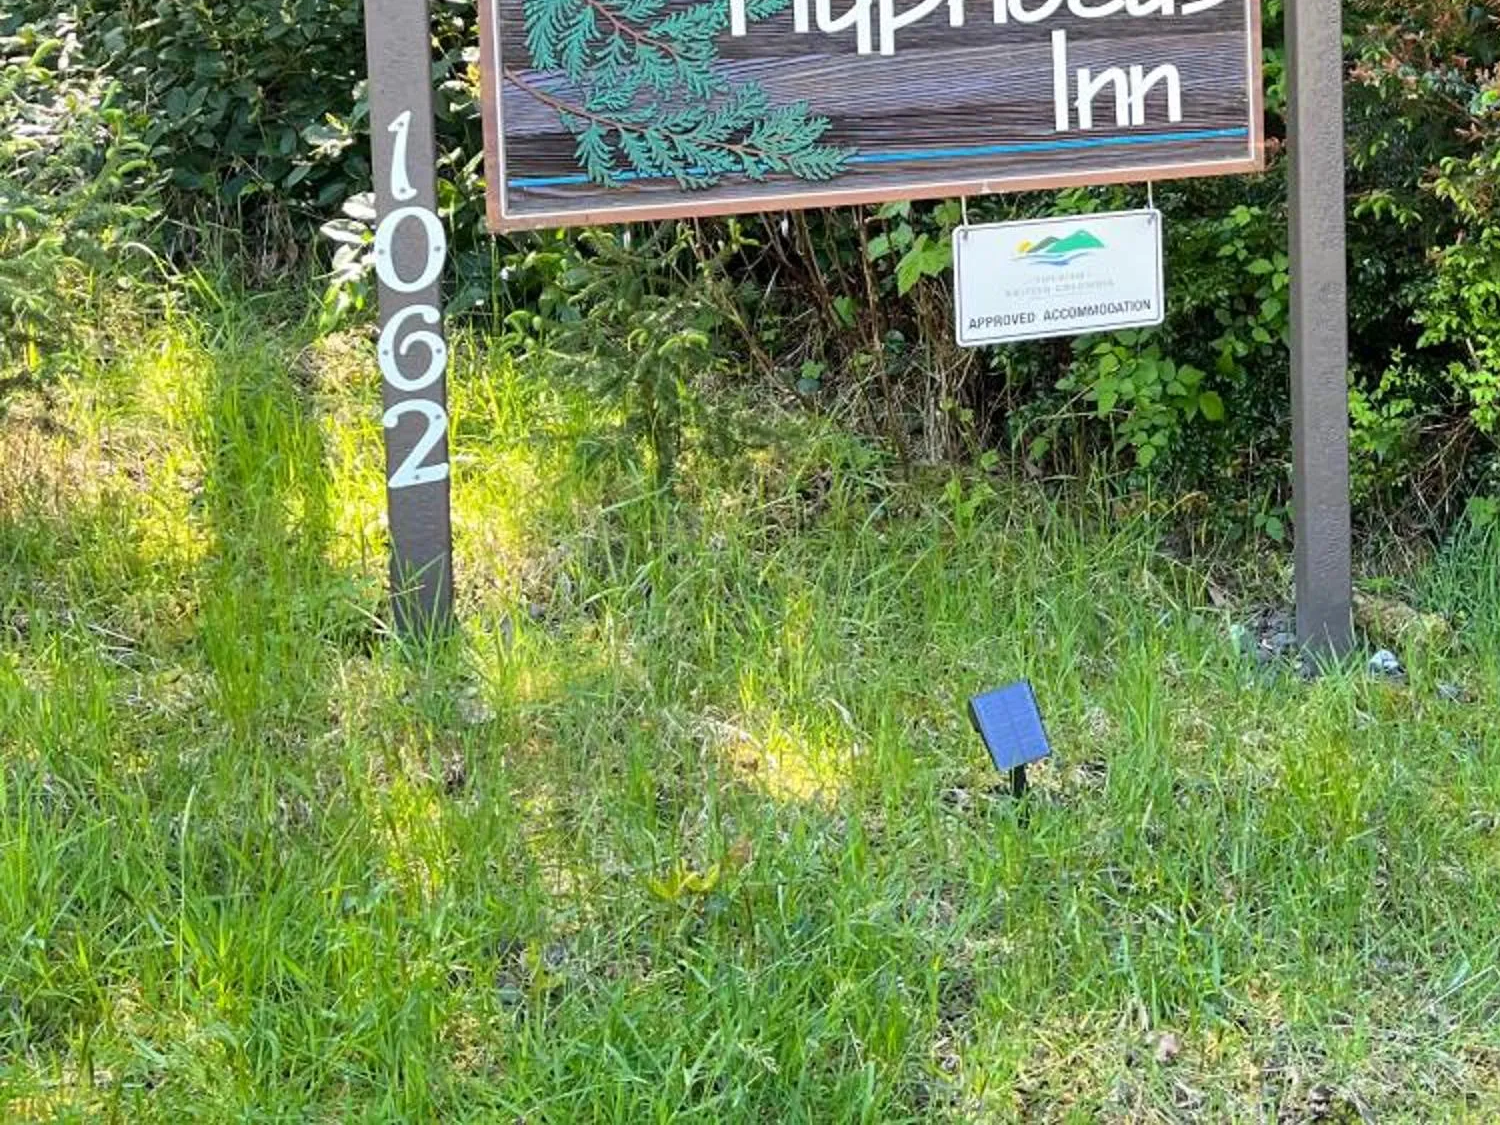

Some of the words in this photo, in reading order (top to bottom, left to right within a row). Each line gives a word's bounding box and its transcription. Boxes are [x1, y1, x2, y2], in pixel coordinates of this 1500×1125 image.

[1051, 29, 1182, 132] Inn
[374, 109, 450, 489] 1062
[968, 312, 1036, 330] APPROVED
[1043, 298, 1152, 322] ACCOMMODATION
